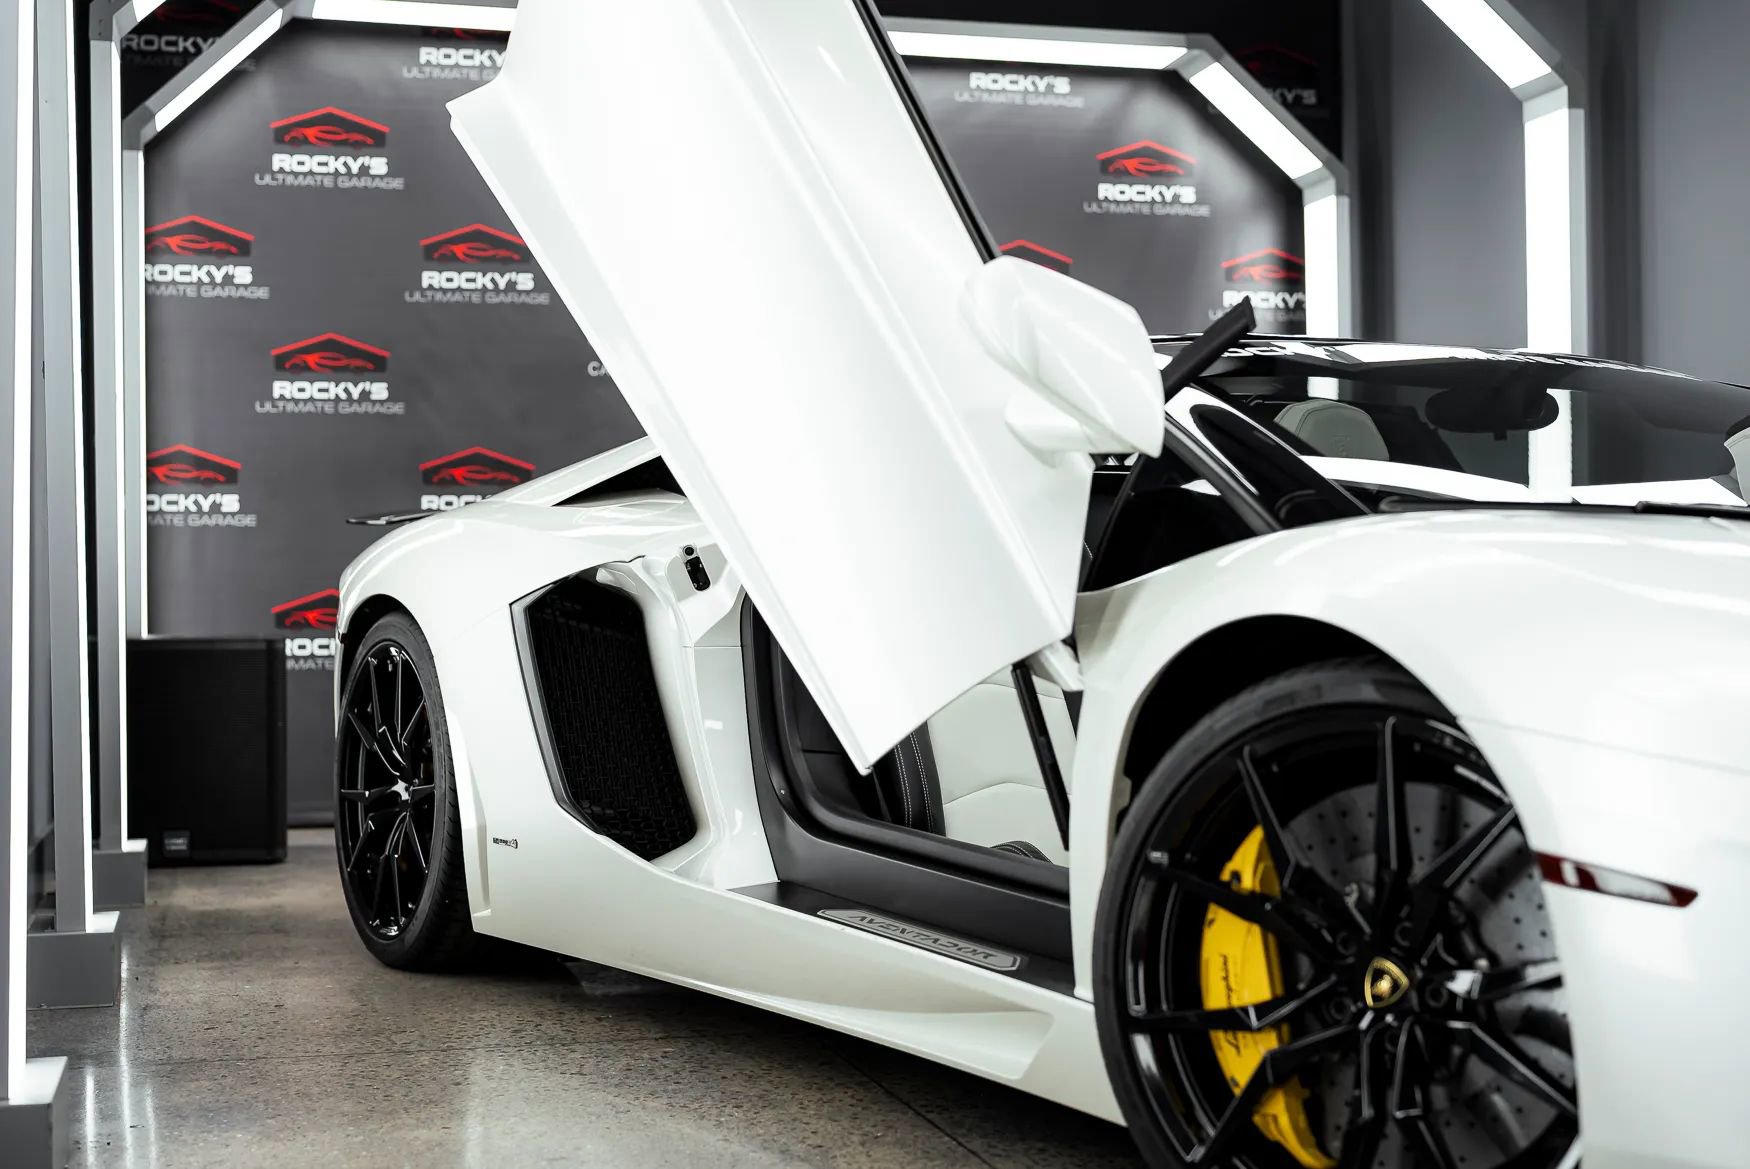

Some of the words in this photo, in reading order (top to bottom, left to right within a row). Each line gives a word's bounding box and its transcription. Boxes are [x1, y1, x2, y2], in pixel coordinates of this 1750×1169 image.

[402, 65, 479, 80] ULTIMATE
[969, 72, 1071, 94] ROCKY'S
[271, 153, 388, 176] ROCKY'S
[254, 173, 335, 188] ULTIMATE
[337, 175, 405, 190] GARAGE
[1097, 183, 1196, 204] ROCKY'S
[1082, 200, 1151, 215] ULTIMATE
[1153, 202, 1210, 217] GARAGE
[421, 270, 535, 290] ROCKY'S
[200, 285, 270, 300] GARAGE
[404, 290, 482, 303] ULTIMATE
[484, 291, 550, 305] GARAGE
[272, 380, 389, 400] ROCKY'S
[254, 400, 335, 414] ULTIMATE
[338, 401, 405, 415] GARAGE
[187, 514, 257, 527] GARAGE
[848, 914, 998, 960] AVENTADOR
